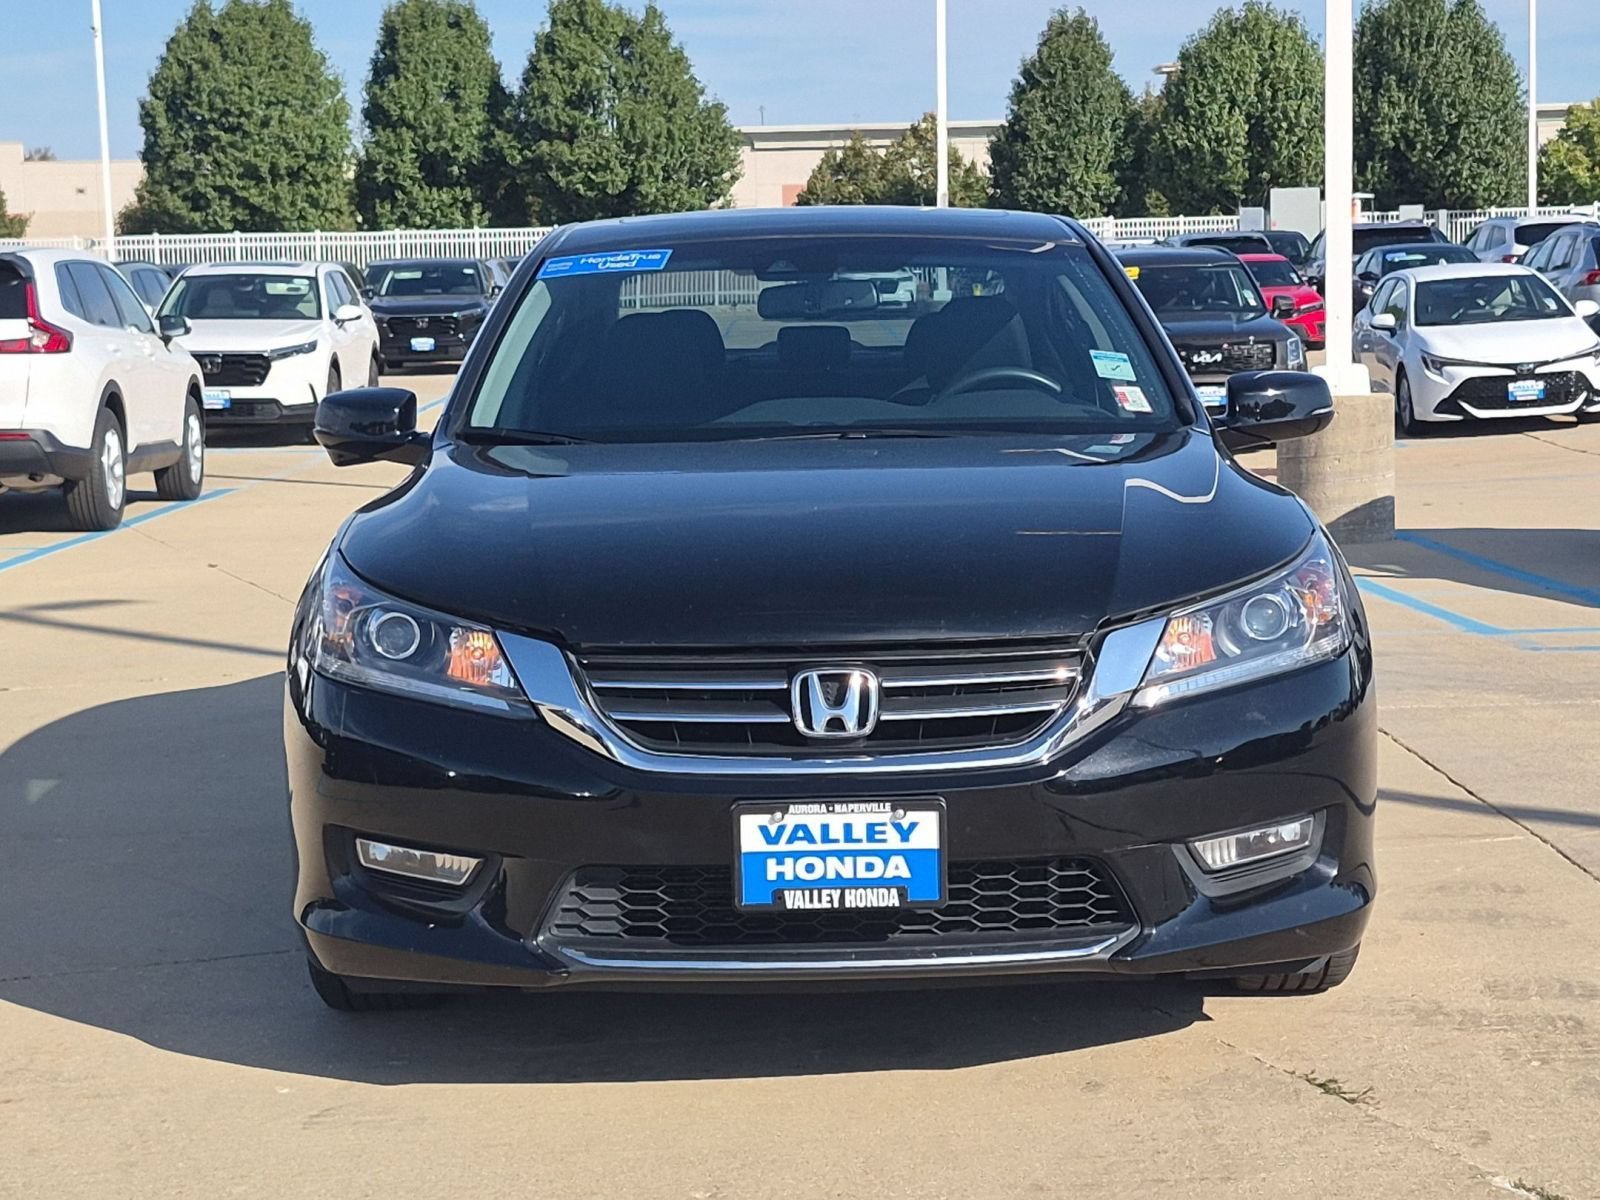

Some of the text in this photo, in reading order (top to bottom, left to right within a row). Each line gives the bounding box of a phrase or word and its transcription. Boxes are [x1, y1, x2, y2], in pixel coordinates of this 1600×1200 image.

[788, 803, 892, 814] AURORA NAPERVILLE
[758, 822, 919, 845] VALLEY
[766, 855, 912, 880] HONDA
[783, 887, 900, 909] VALLEY HONDA
